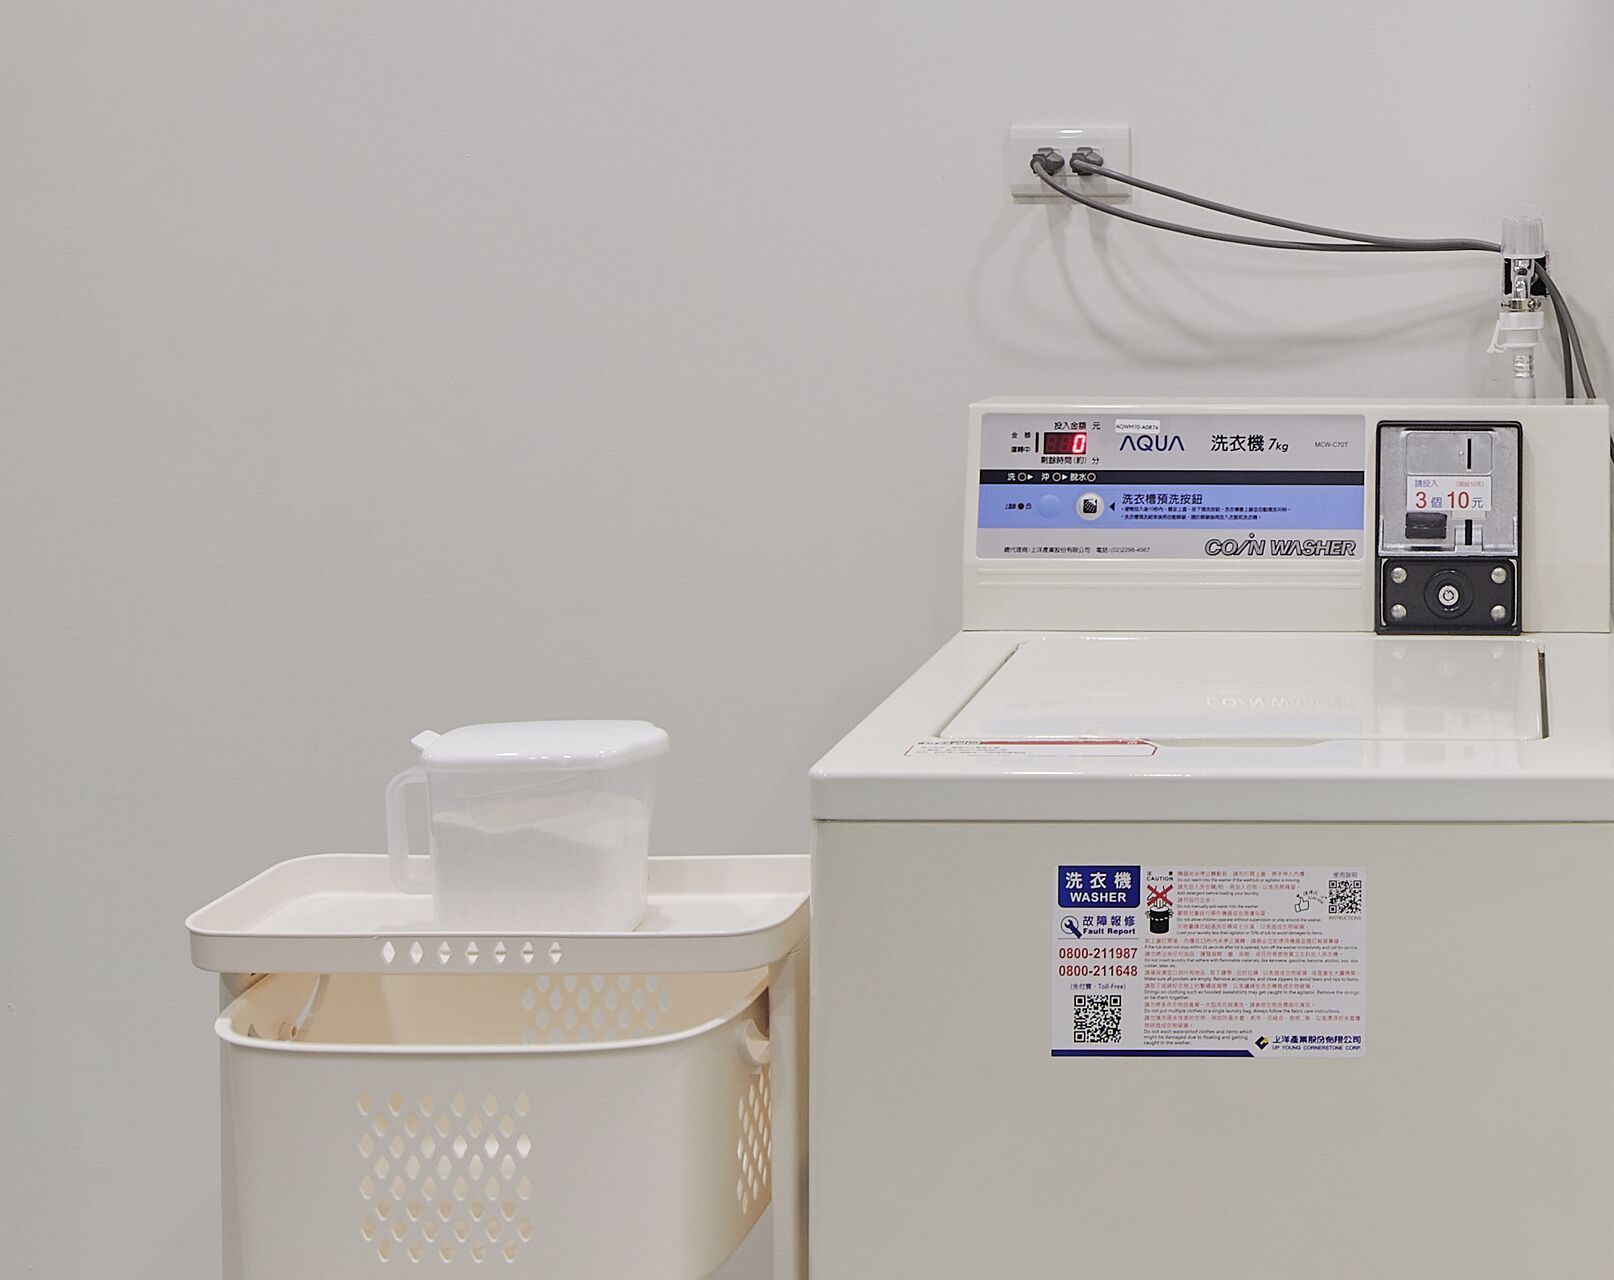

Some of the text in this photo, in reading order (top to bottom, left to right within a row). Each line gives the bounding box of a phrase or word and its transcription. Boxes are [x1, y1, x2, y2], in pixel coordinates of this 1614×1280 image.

[1072, 434, 1086, 454] 0
[1120, 434, 1184, 452] AQUA
[1210, 434, 1289, 452] 洗衣機 7kg
[1415, 492, 1484, 509] 3 個 10 元
[1204, 532, 1357, 556] COIN WASHER
[1066, 872, 1132, 890] 洗衣機
[1070, 892, 1127, 902] WASHER
[1083, 915, 1135, 927] 故障報修
[1108, 928, 1136, 936] Report
[1058, 948, 1138, 959] 0800-211987
[1058, 965, 1138, 977] 0800-211648
